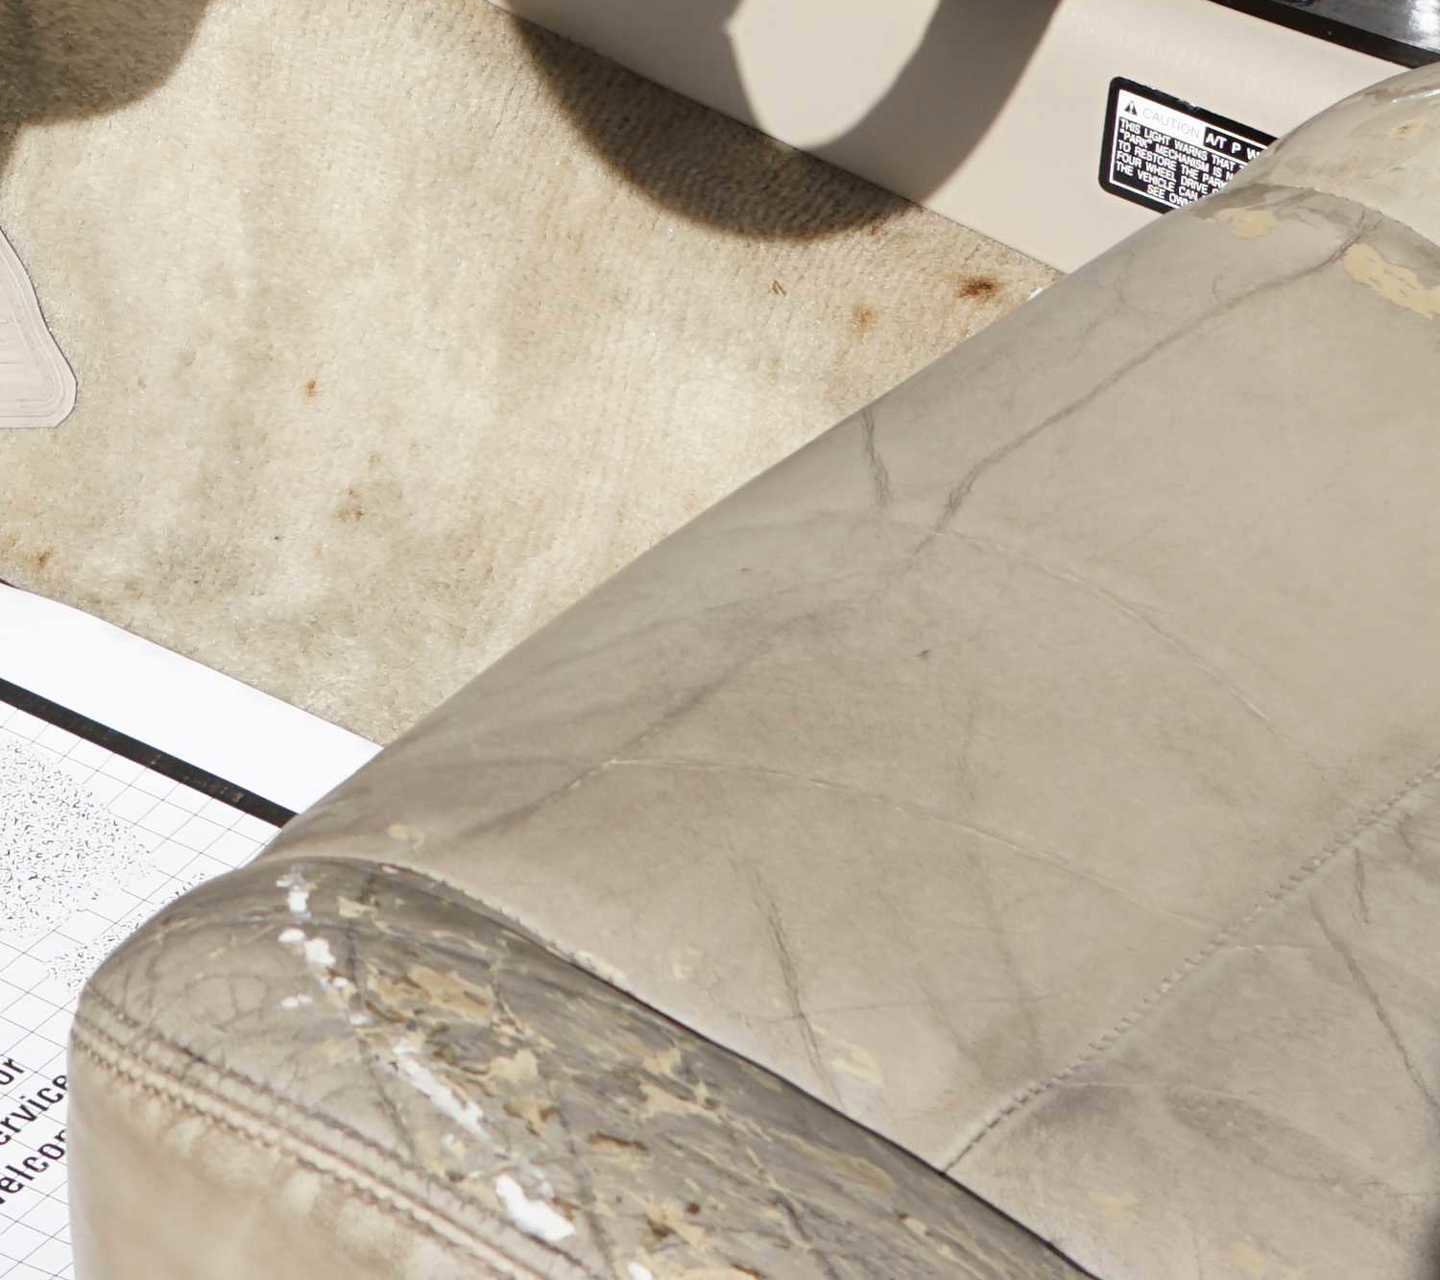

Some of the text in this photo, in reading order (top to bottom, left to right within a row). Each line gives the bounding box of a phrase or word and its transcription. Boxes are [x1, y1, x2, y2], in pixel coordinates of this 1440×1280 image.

[1120, 119, 1237, 172] THIS LIGHT WARNS THAT
[1141, 107, 1201, 138] CAUTION
[1231, 142, 1242, 154] P
[1116, 151, 1209, 194] FOUR WHEEL DRIVE
[1118, 140, 1132, 153] TO
[1134, 146, 1177, 171] RESTORE
[1180, 163, 1200, 180] THE
[1155, 144, 1210, 173] MECHANISM
[1212, 165, 1223, 178] IS
[1115, 161, 1134, 177] THE
[1137, 170, 1176, 192] VEHICLE
[1178, 186, 1199, 201] CAN
[1147, 184, 1166, 199] SEE
